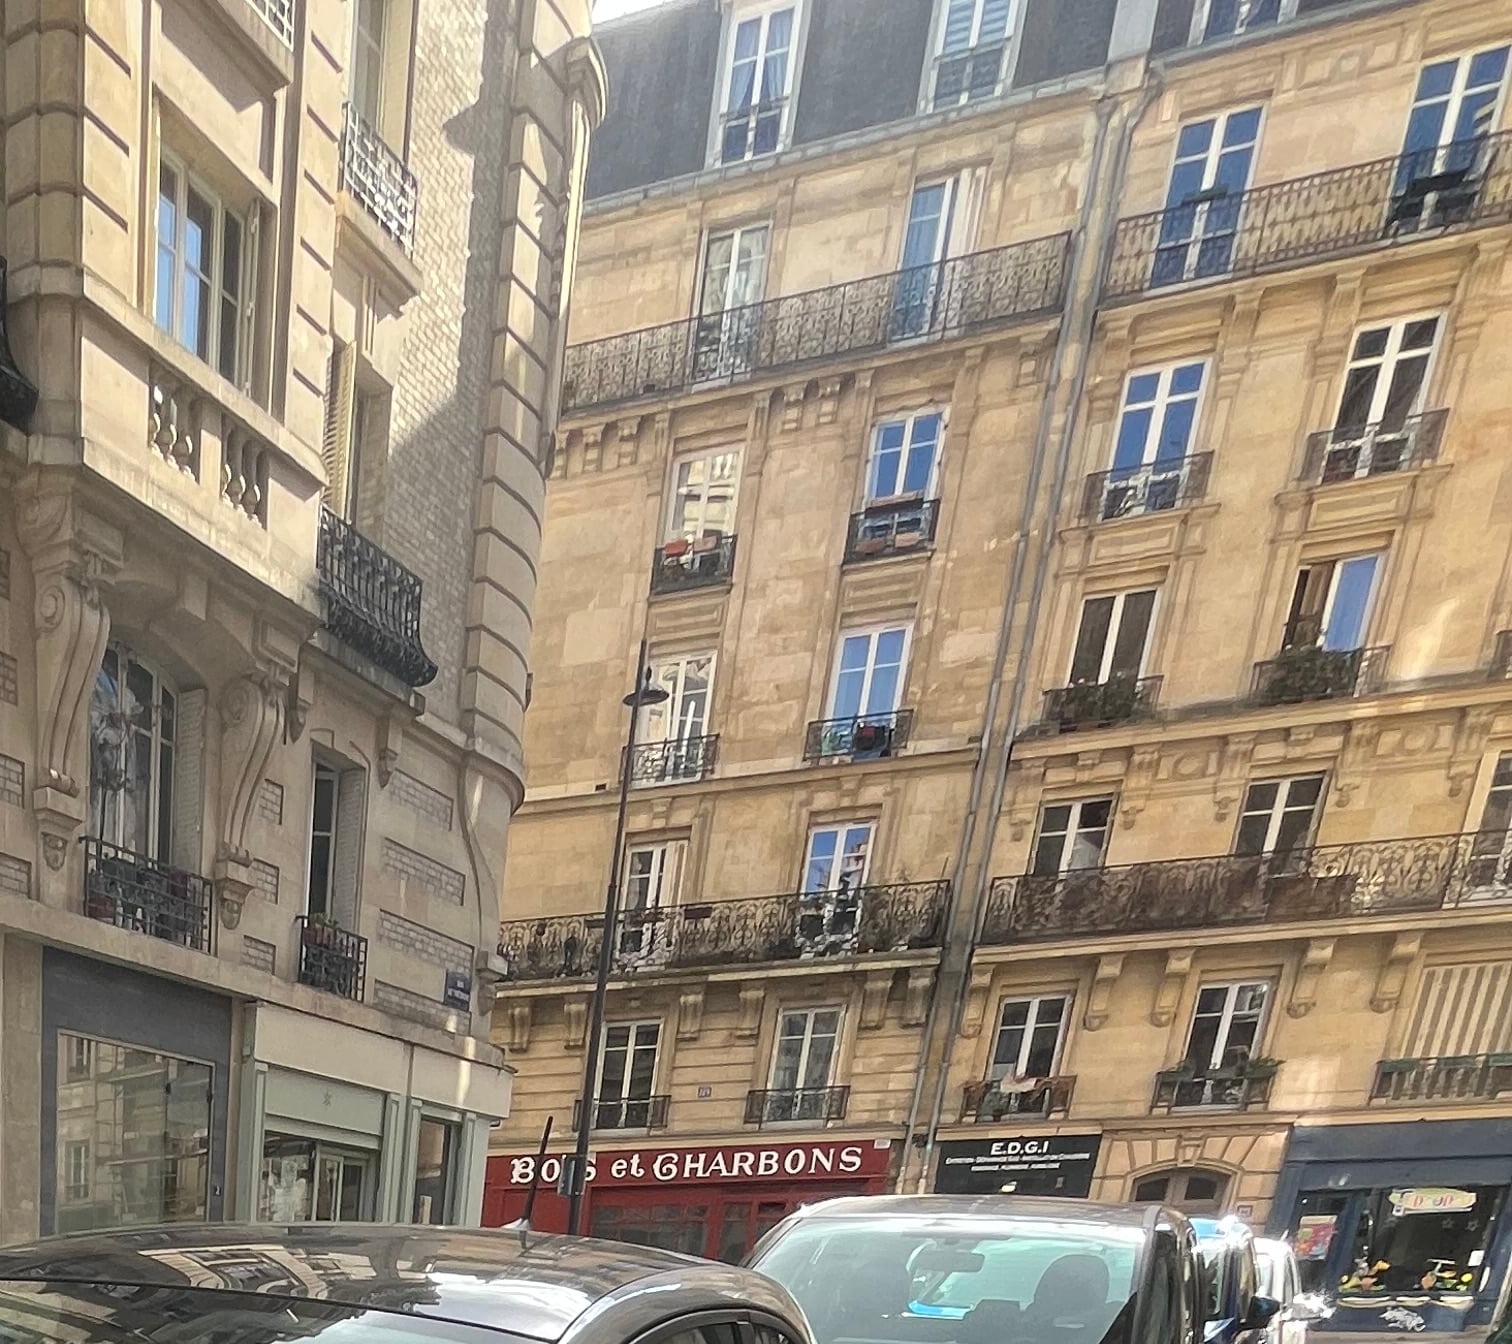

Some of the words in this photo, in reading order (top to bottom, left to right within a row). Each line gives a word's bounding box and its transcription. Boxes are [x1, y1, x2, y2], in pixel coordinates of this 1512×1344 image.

[511, 1156, 597, 1184] BOS
[611, 1153, 645, 1179] et
[653, 1146, 863, 1181] CHARBONS
